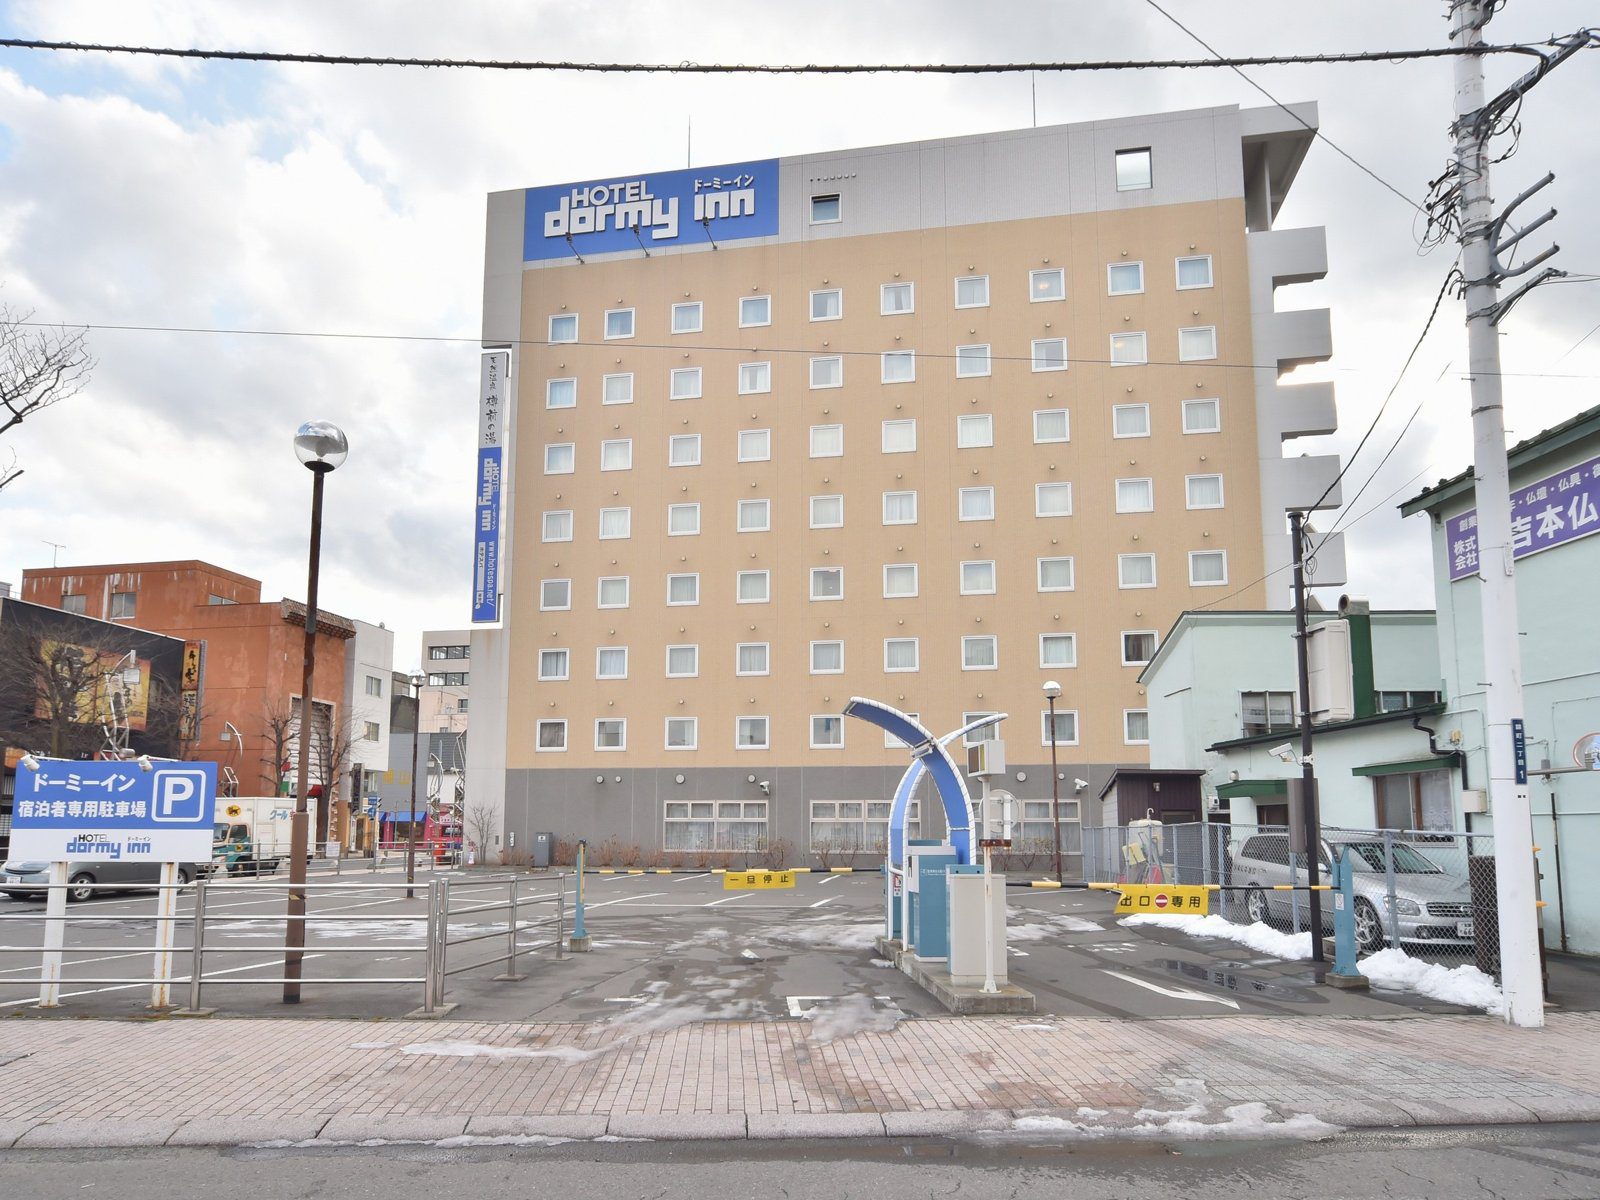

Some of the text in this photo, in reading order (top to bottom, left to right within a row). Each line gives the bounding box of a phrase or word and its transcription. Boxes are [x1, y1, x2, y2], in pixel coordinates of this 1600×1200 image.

[694, 174, 754, 192] ドーミーイン
[571, 180, 654, 208] HOTEL
[544, 188, 756, 240] dormy inn
[492, 466, 500, 493] HOTEL
[478, 458, 498, 532] dormy inn
[1454, 536, 1477, 556] 株式
[1455, 552, 1478, 571] 会社
[34, 773, 136, 792] ドーミーイン
[162, 776, 194, 815] P
[18, 800, 146, 818] 宿泊者専用駐車場
[66, 837, 150, 859] dormy inn
[78, 834, 110, 843] HOTEL
[730, 874, 788, 884] 一旦停止
[1171, 896, 1200, 908] 専用
